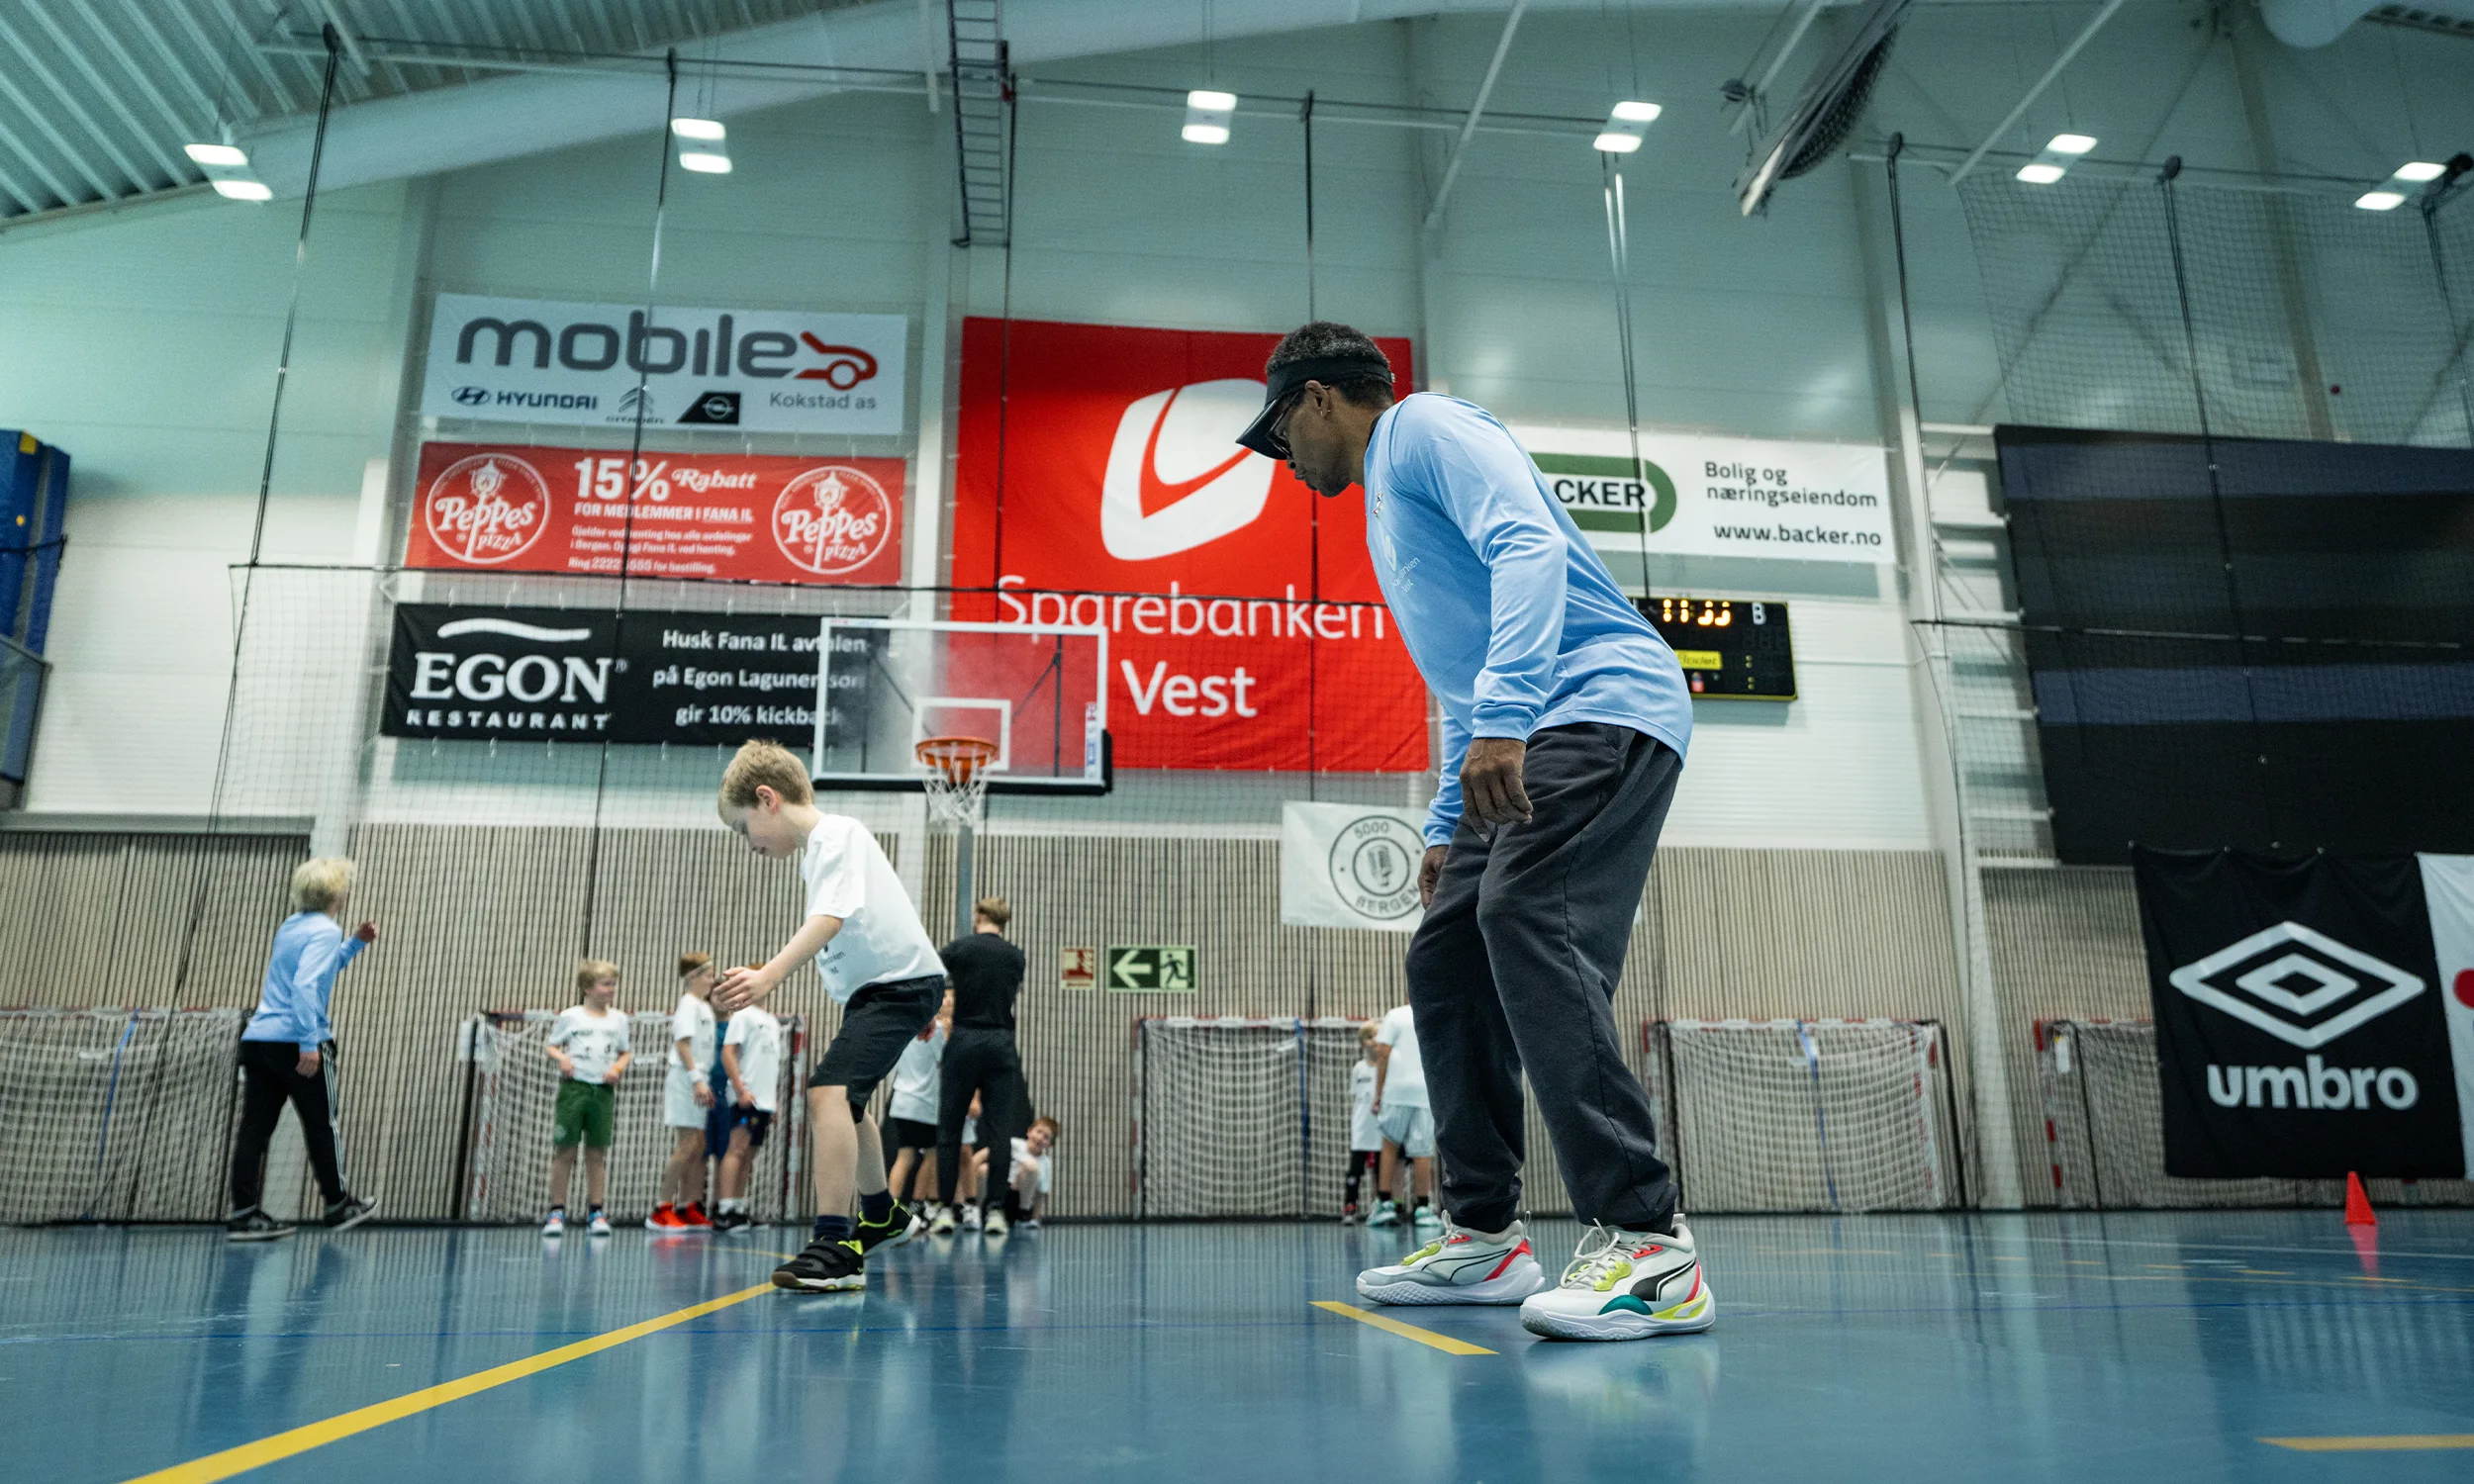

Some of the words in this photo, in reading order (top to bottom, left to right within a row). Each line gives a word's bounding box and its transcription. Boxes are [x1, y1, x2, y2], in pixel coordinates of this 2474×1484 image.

[455, 308, 799, 380] mobile
[496, 391, 599, 411] HYUNDAI
[769, 392, 850, 409] Kokstad
[855, 397, 876, 411] as
[574, 457, 670, 502] 15%
[672, 468, 757, 493] Rabatt
[1704, 461, 1758, 486] Bolig
[1762, 467, 1787, 486] og
[1555, 479, 1646, 508] CKER
[1707, 485, 1878, 509] næringseiendom
[434, 495, 537, 533] Peppes
[574, 502, 601, 517] FOR
[703, 507, 738, 522] FANA
[740, 508, 753, 522] IL
[781, 508, 879, 544] Peppes
[1713, 523, 1882, 546] www.backer.no
[998, 575, 1384, 644] Sparebanken
[662, 629, 714, 651] Husk
[717, 632, 766, 652] Fana
[771, 633, 789, 652] IL
[410, 652, 615, 703] EGON
[652, 665, 680, 689] på
[683, 667, 734, 691] Egon
[1120, 659, 1258, 718] Vest
[406, 708, 612, 731] RESTAURANT
[675, 703, 706, 726] gir
[709, 704, 751, 725] 10%
[1354, 821, 1390, 839] 5000
[2207, 1054, 2419, 1111] umbro
